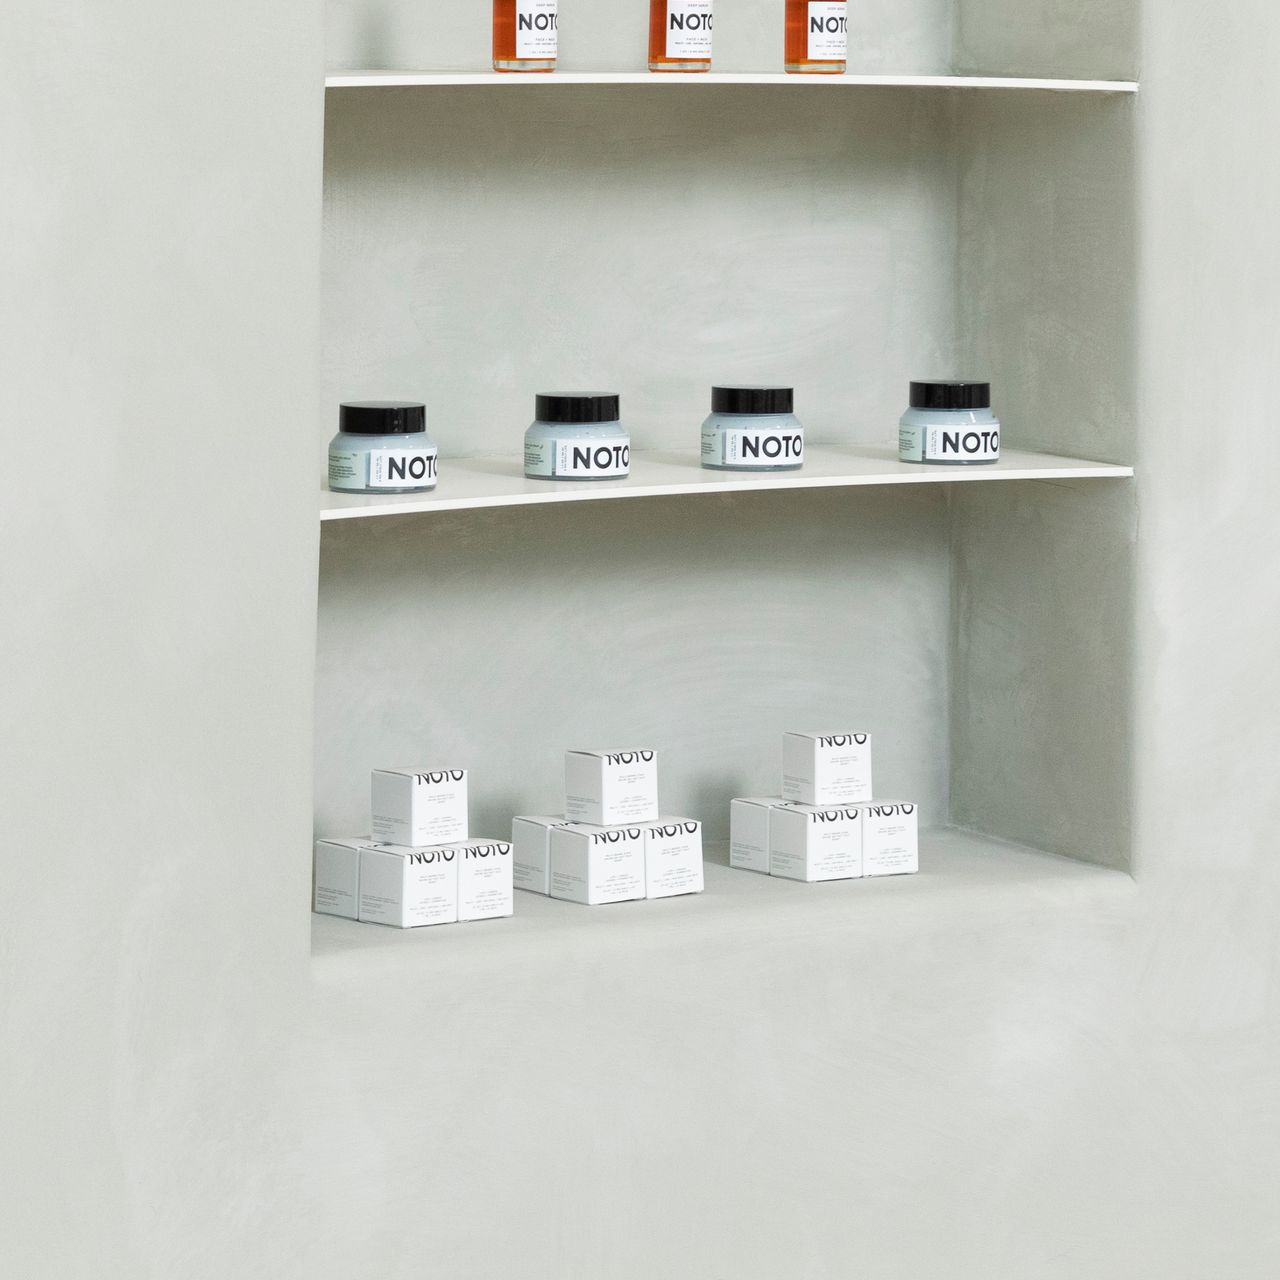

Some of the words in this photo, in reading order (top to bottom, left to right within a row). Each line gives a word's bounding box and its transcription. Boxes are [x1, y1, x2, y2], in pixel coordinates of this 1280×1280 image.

[742, 434, 802, 458] NOTO
[942, 431, 998, 453] NOTO
[572, 445, 629, 469] NOTO
